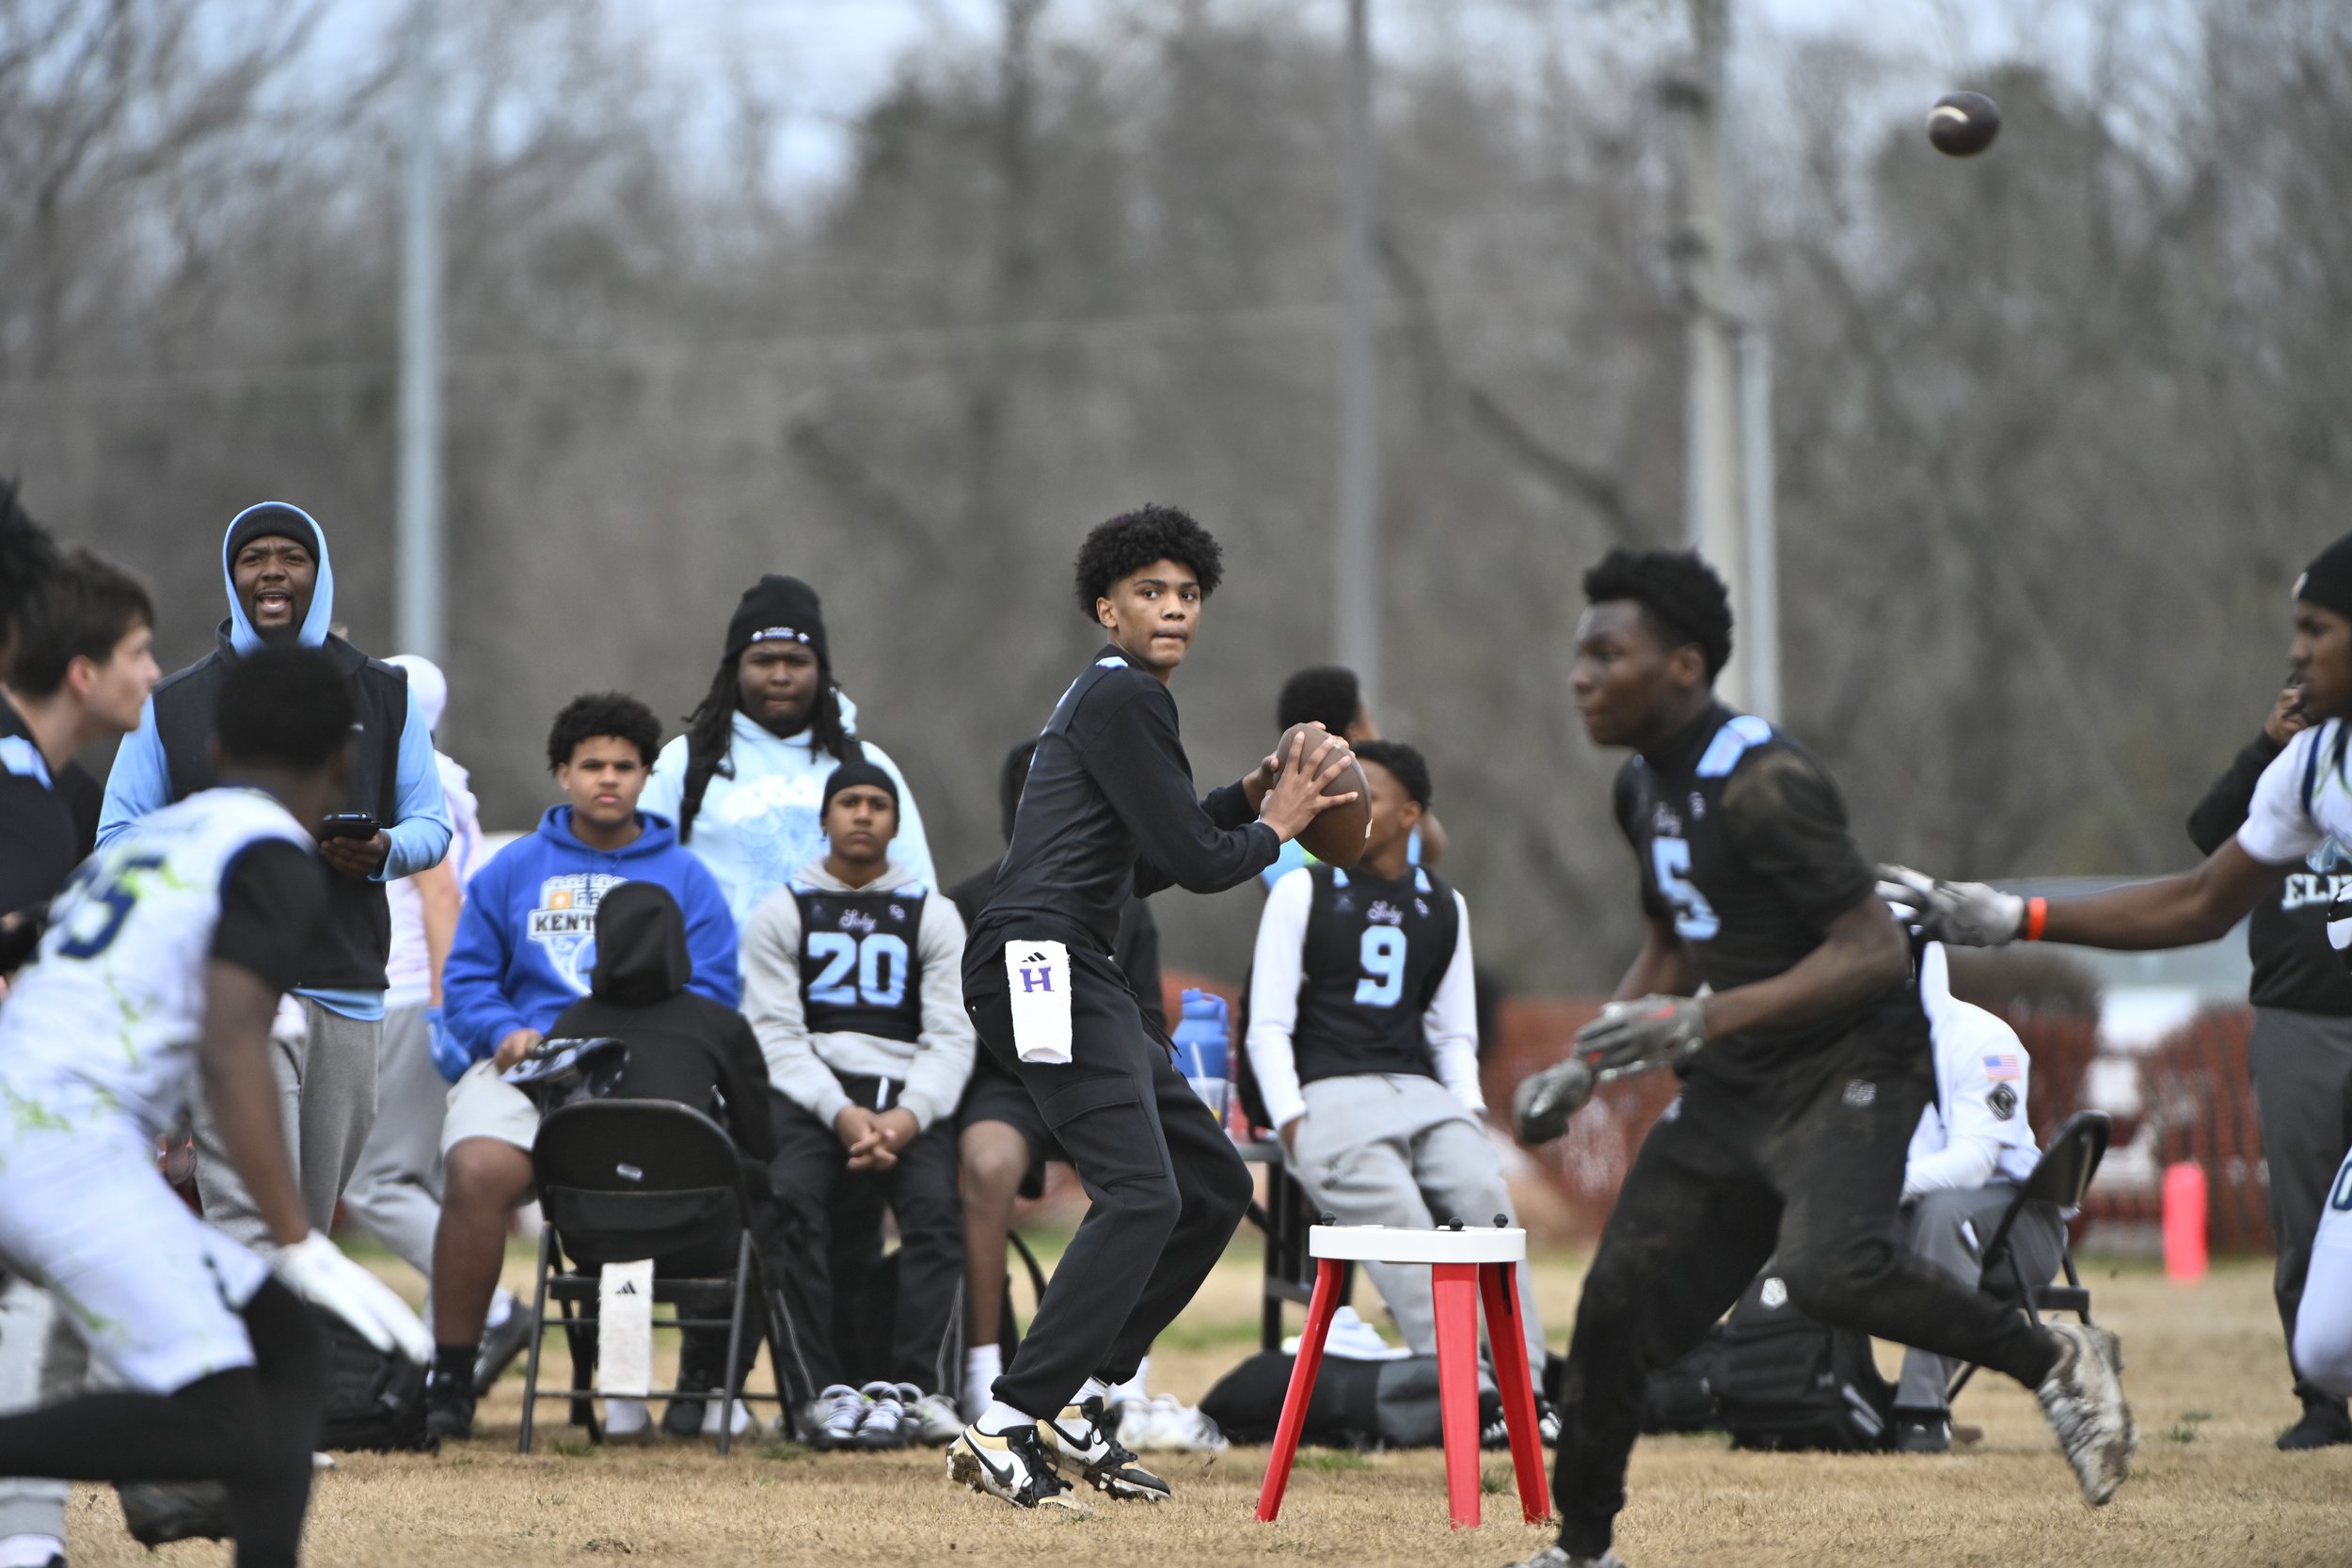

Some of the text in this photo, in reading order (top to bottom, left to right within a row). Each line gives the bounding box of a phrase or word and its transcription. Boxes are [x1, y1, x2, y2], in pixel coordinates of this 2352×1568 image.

[1651, 835, 1721, 940] 5
[807, 931, 909, 1006] 20
[1019, 965, 1055, 993] H
[1354, 925, 1407, 1008] 9
